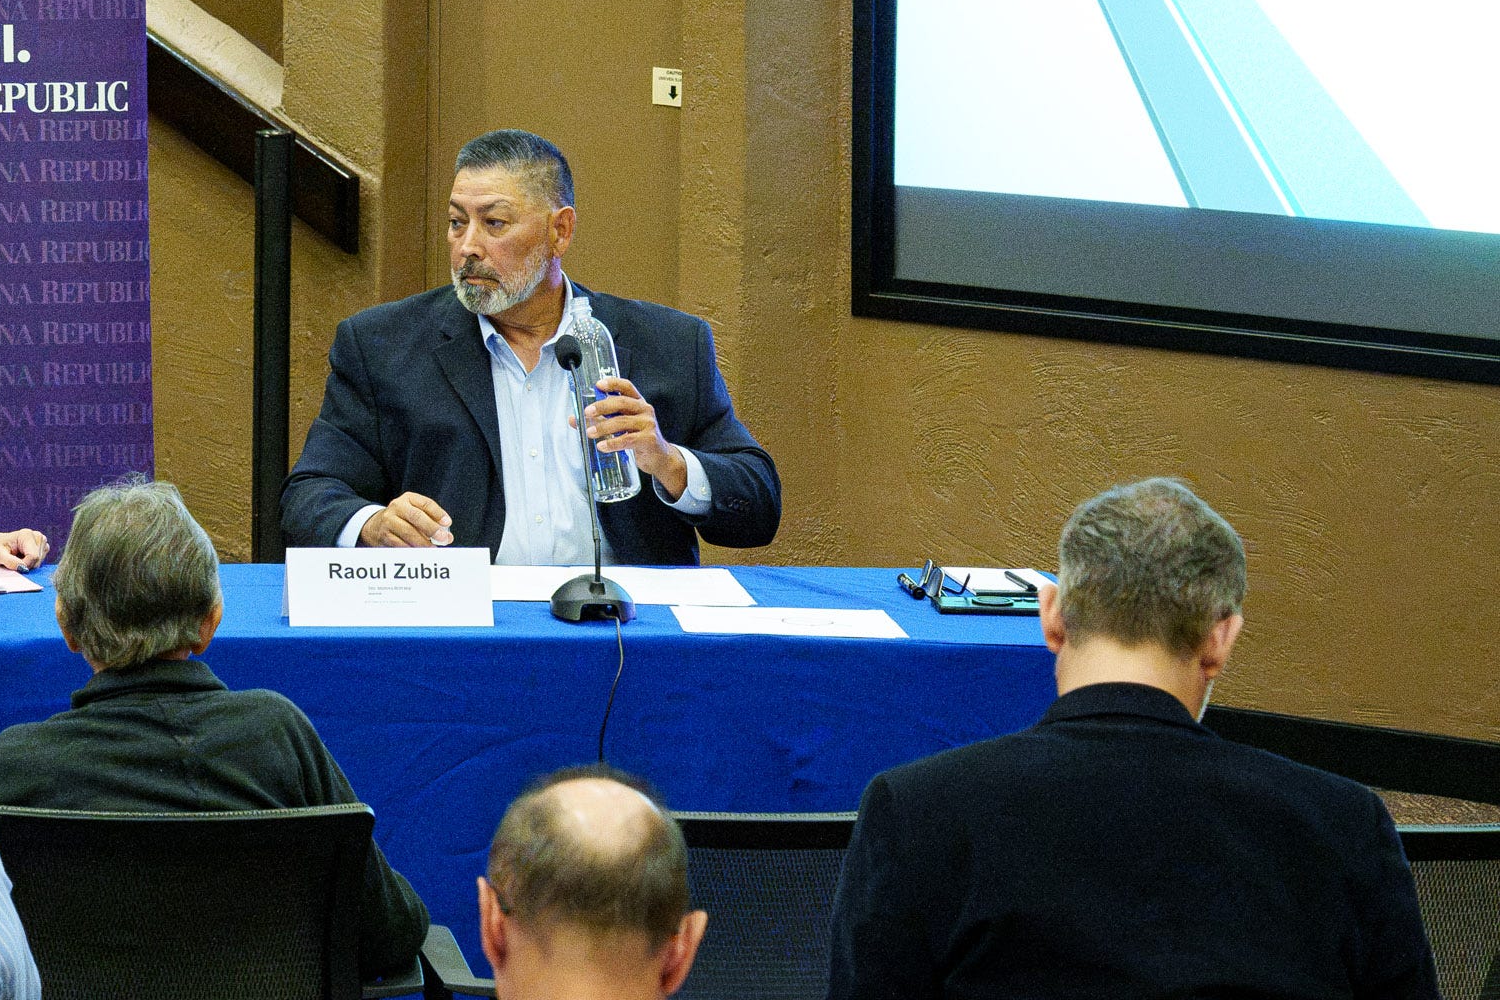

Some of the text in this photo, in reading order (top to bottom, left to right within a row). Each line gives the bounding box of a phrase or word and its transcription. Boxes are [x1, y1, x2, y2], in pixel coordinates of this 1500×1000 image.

[43, 402, 152, 427] REPUBLI
[328, 562, 451, 580] Raoul Zubia
